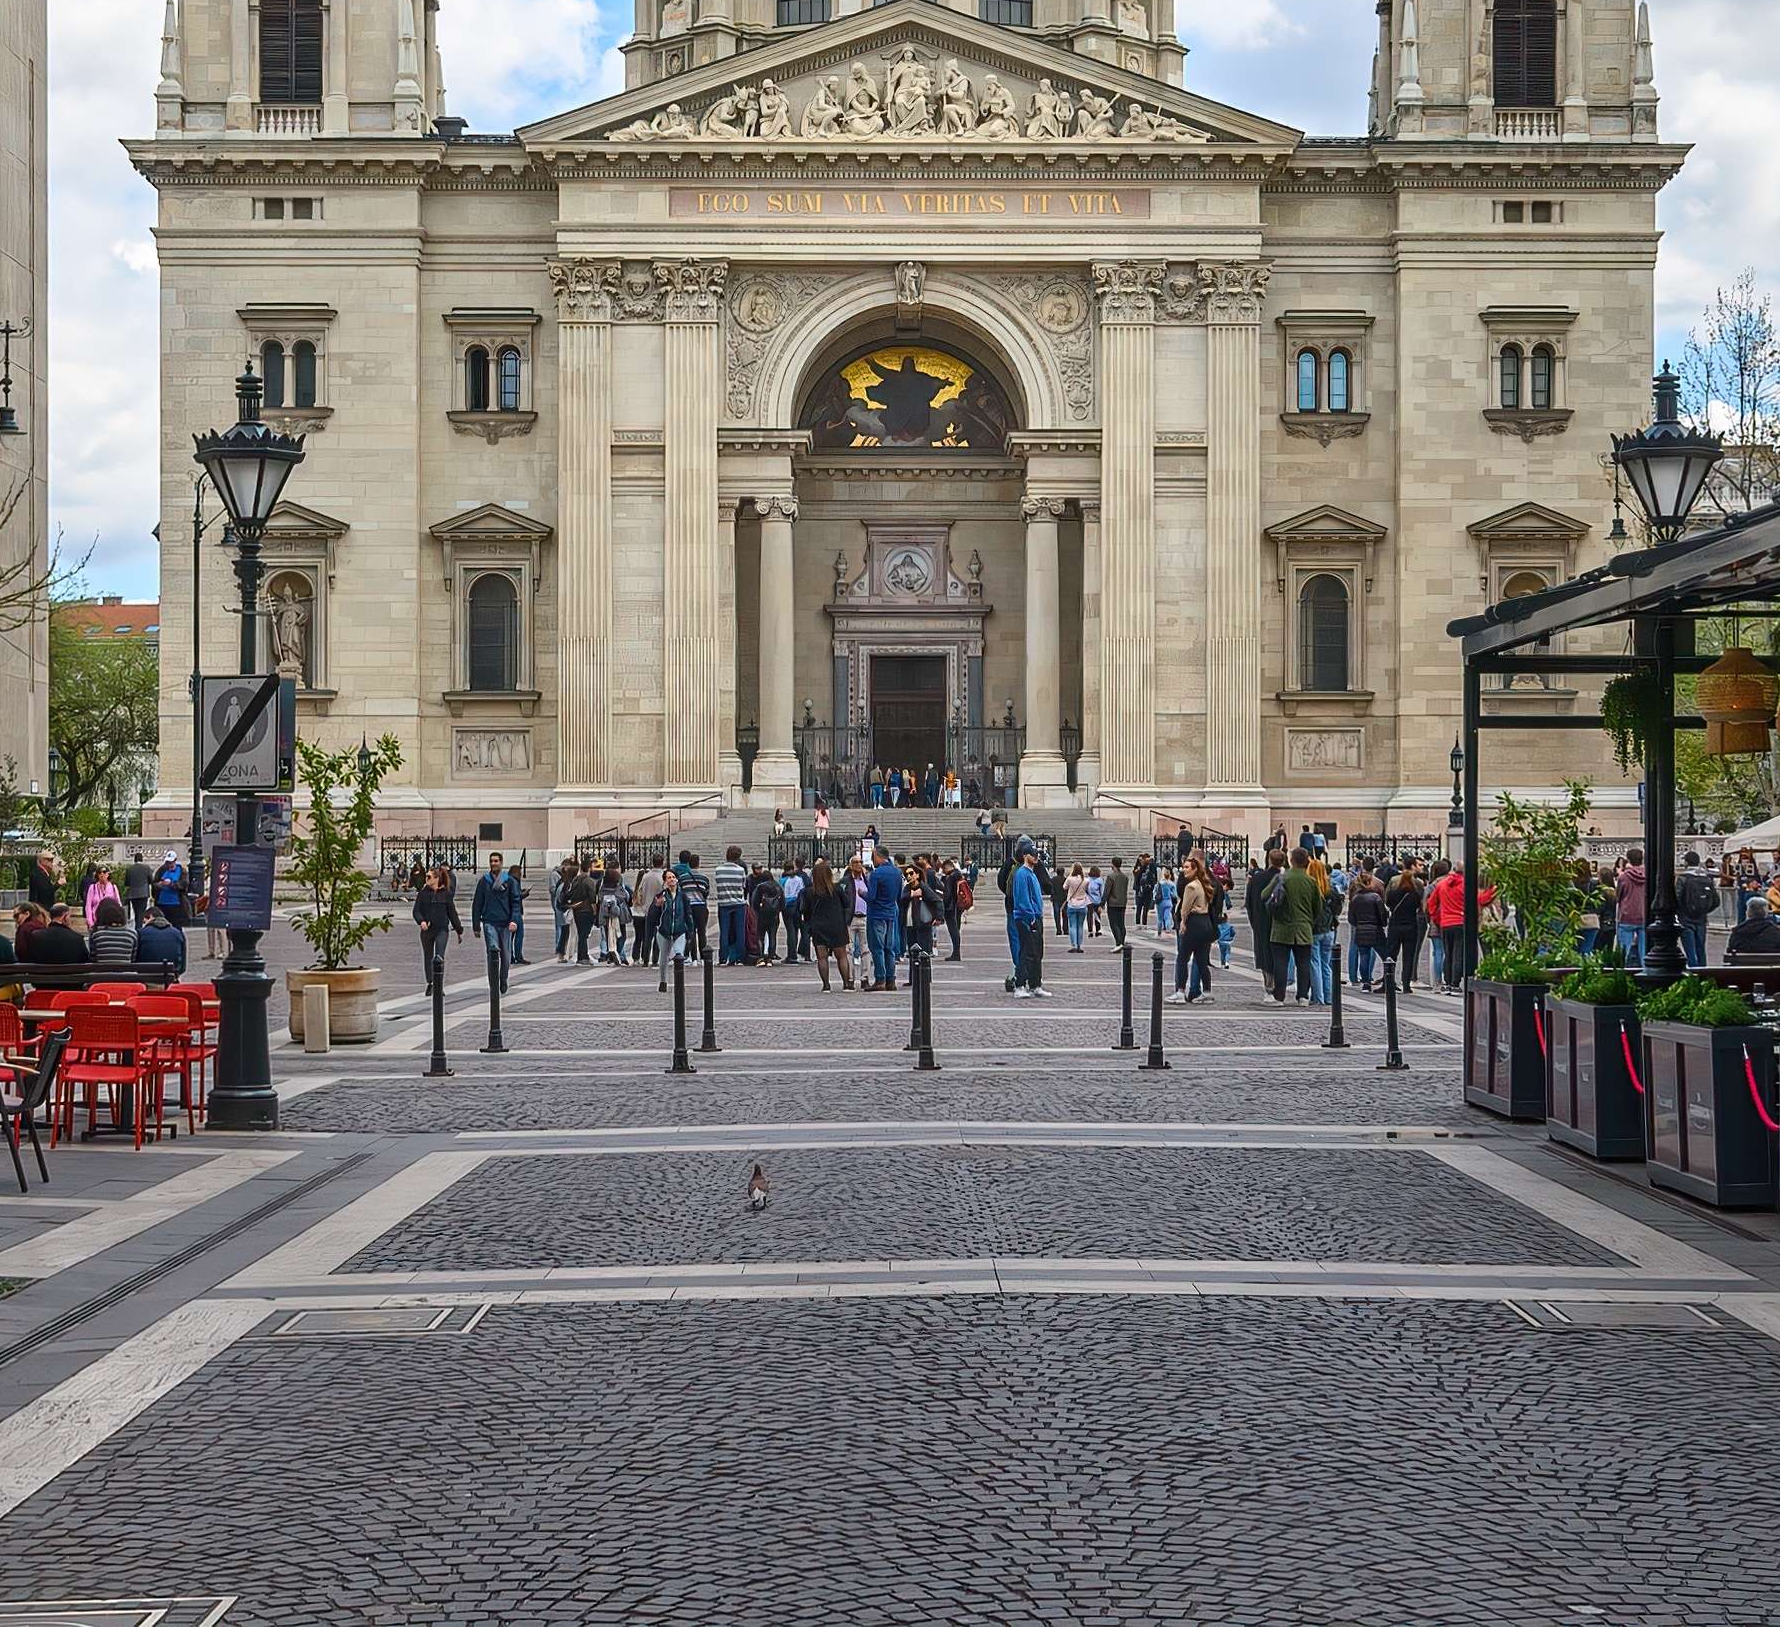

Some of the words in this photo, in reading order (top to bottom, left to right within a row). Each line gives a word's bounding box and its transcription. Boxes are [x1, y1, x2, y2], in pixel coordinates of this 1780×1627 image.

[697, 192, 750, 214] EGO
[766, 192, 822, 214] SUM
[842, 192, 887, 214] VIA
[901, 192, 1006, 214] VERITAS
[1022, 192, 1052, 214] ET
[1067, 192, 1122, 214] VITA
